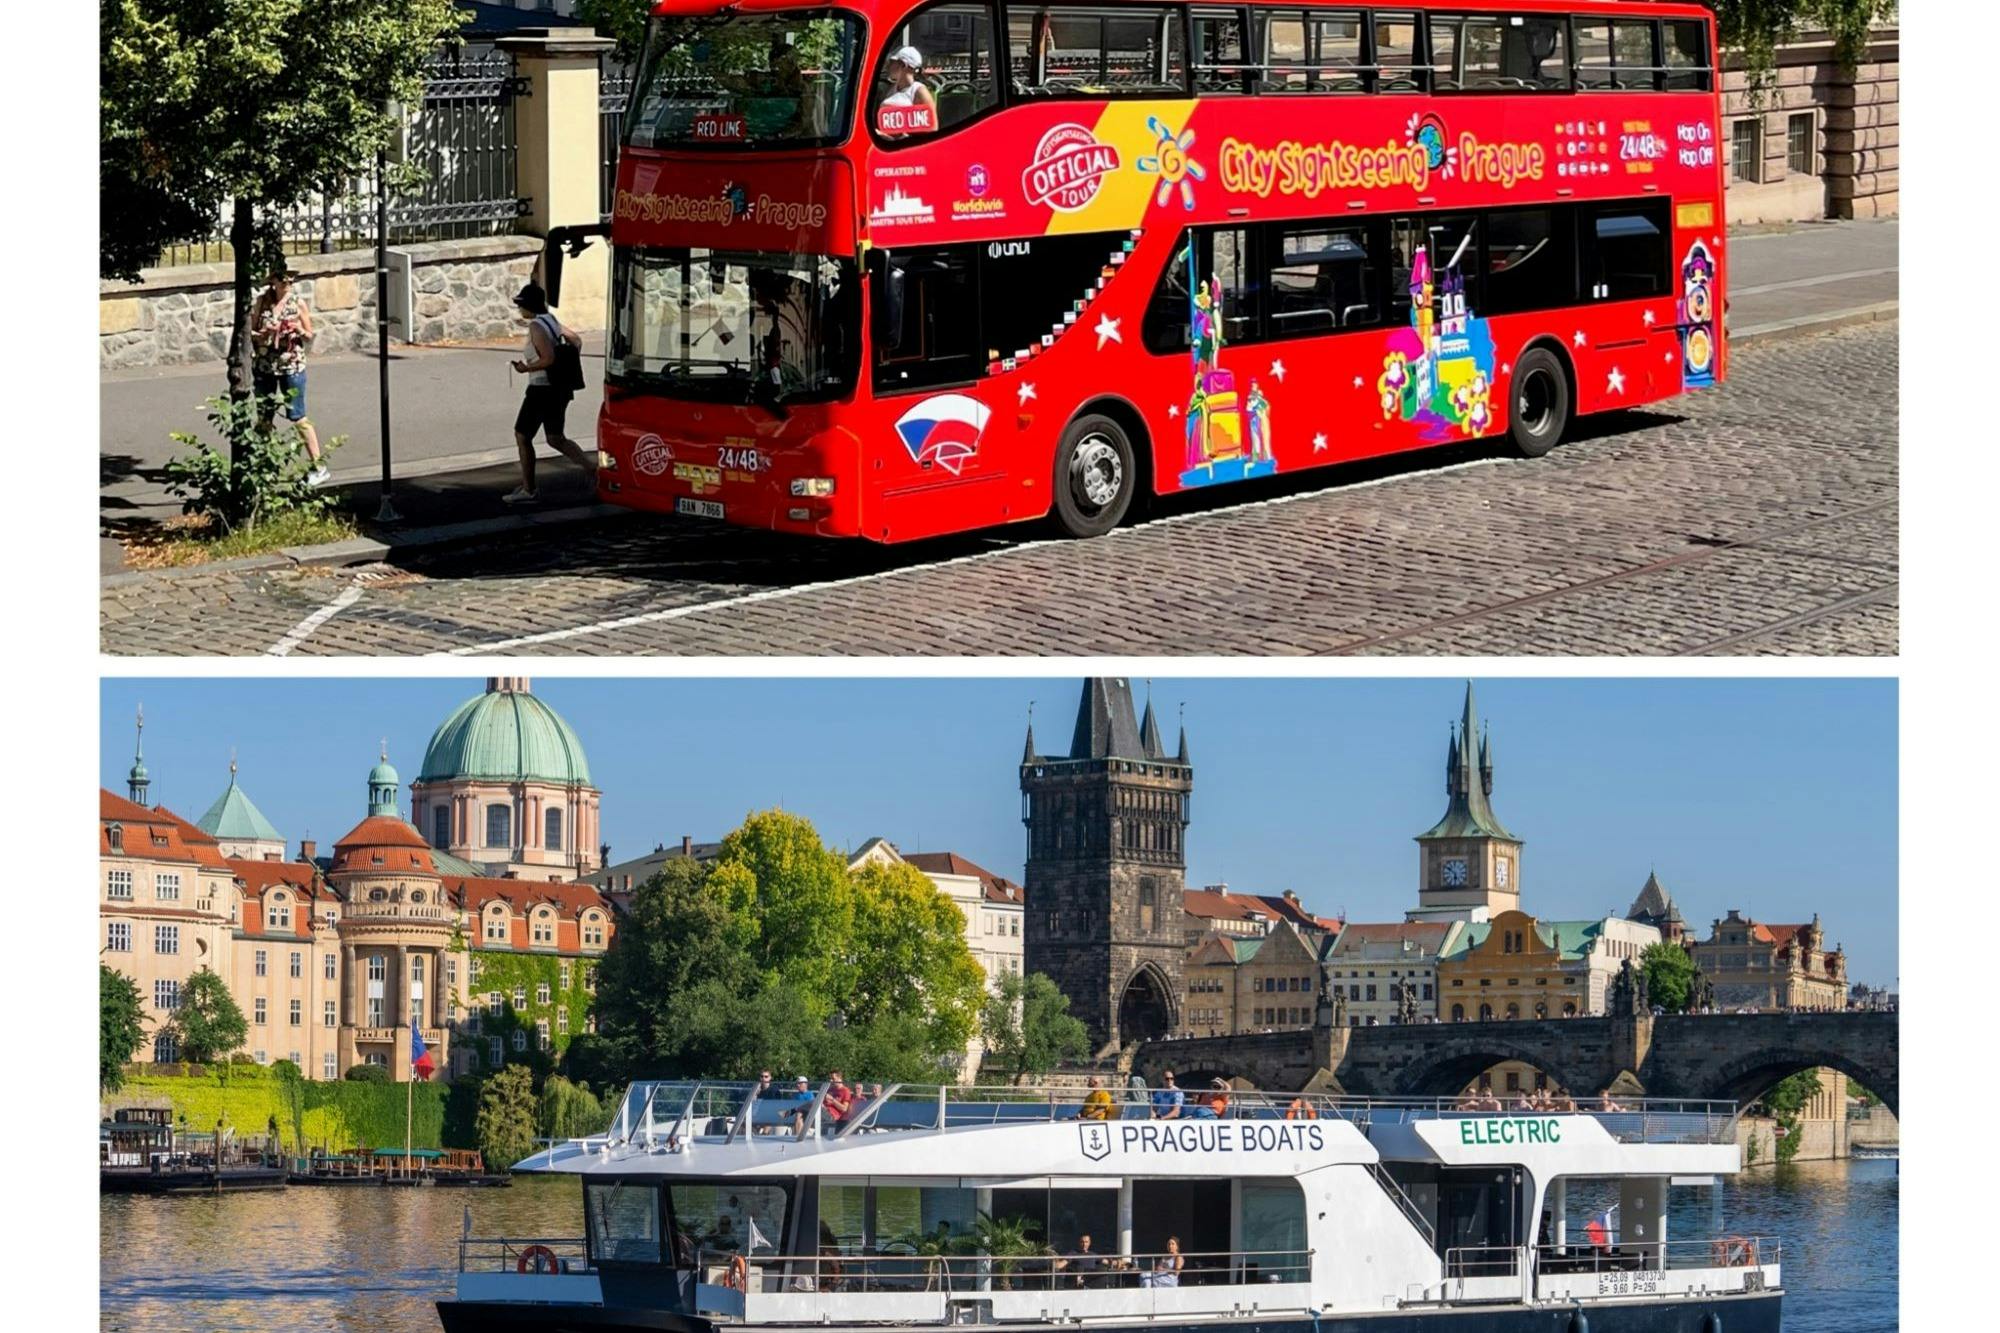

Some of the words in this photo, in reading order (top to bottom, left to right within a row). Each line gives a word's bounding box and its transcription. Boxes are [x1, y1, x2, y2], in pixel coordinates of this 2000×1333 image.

[697, 120, 717, 137] RED
[720, 120, 740, 137] LINE
[882, 111, 903, 129] RED
[908, 110, 930, 127] LINE
[1677, 125, 1696, 143] Hop
[1697, 122, 1711, 141] On
[1620, 134, 1655, 160] 24/48
[1679, 148, 1698, 168] Hop
[1698, 146, 1713, 165] Off
[873, 167, 915, 178] OPERATED
[1033, 148, 1116, 194] OFFICIAL
[1459, 131, 1545, 189] Prague
[1061, 180, 1097, 206] TOUR
[756, 194, 827, 231] Prague
[636, 447, 673, 467] OFFICIAL
[718, 447, 757, 472] 24/48
[1122, 1125, 1233, 1153] PRAGUE
[1241, 1124, 1324, 1152] BOATS
[1460, 1119, 1561, 1144] ELECTRIC
